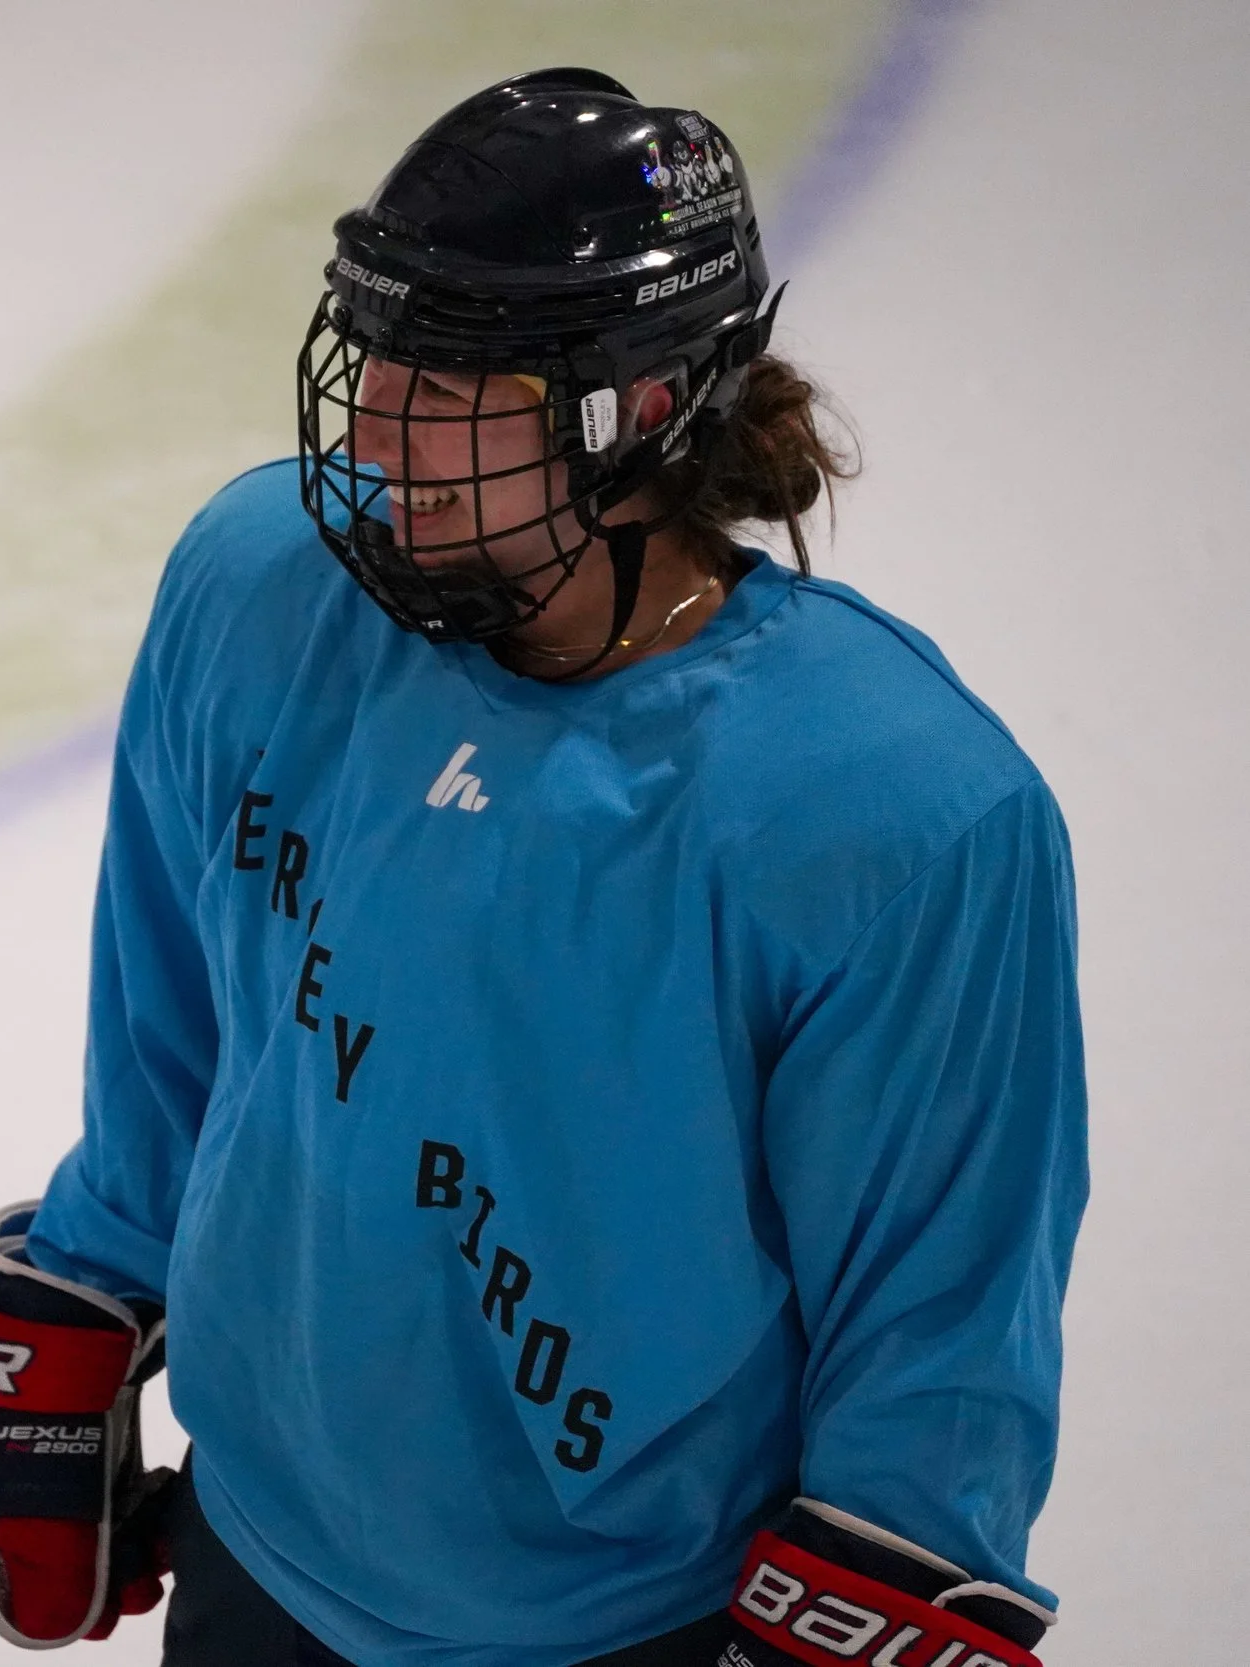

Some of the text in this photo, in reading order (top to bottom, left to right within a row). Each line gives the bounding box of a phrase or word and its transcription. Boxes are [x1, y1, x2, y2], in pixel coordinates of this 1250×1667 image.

[336, 257, 411, 300] BAUER
[635, 249, 736, 306] BAUER
[585, 397, 598, 449] BAUER
[661, 367, 717, 454] BAUER
[234, 750, 375, 1105] EREY
[415, 1139, 613, 1474] BIRDS
[737, 1562, 1008, 1667] BAU
